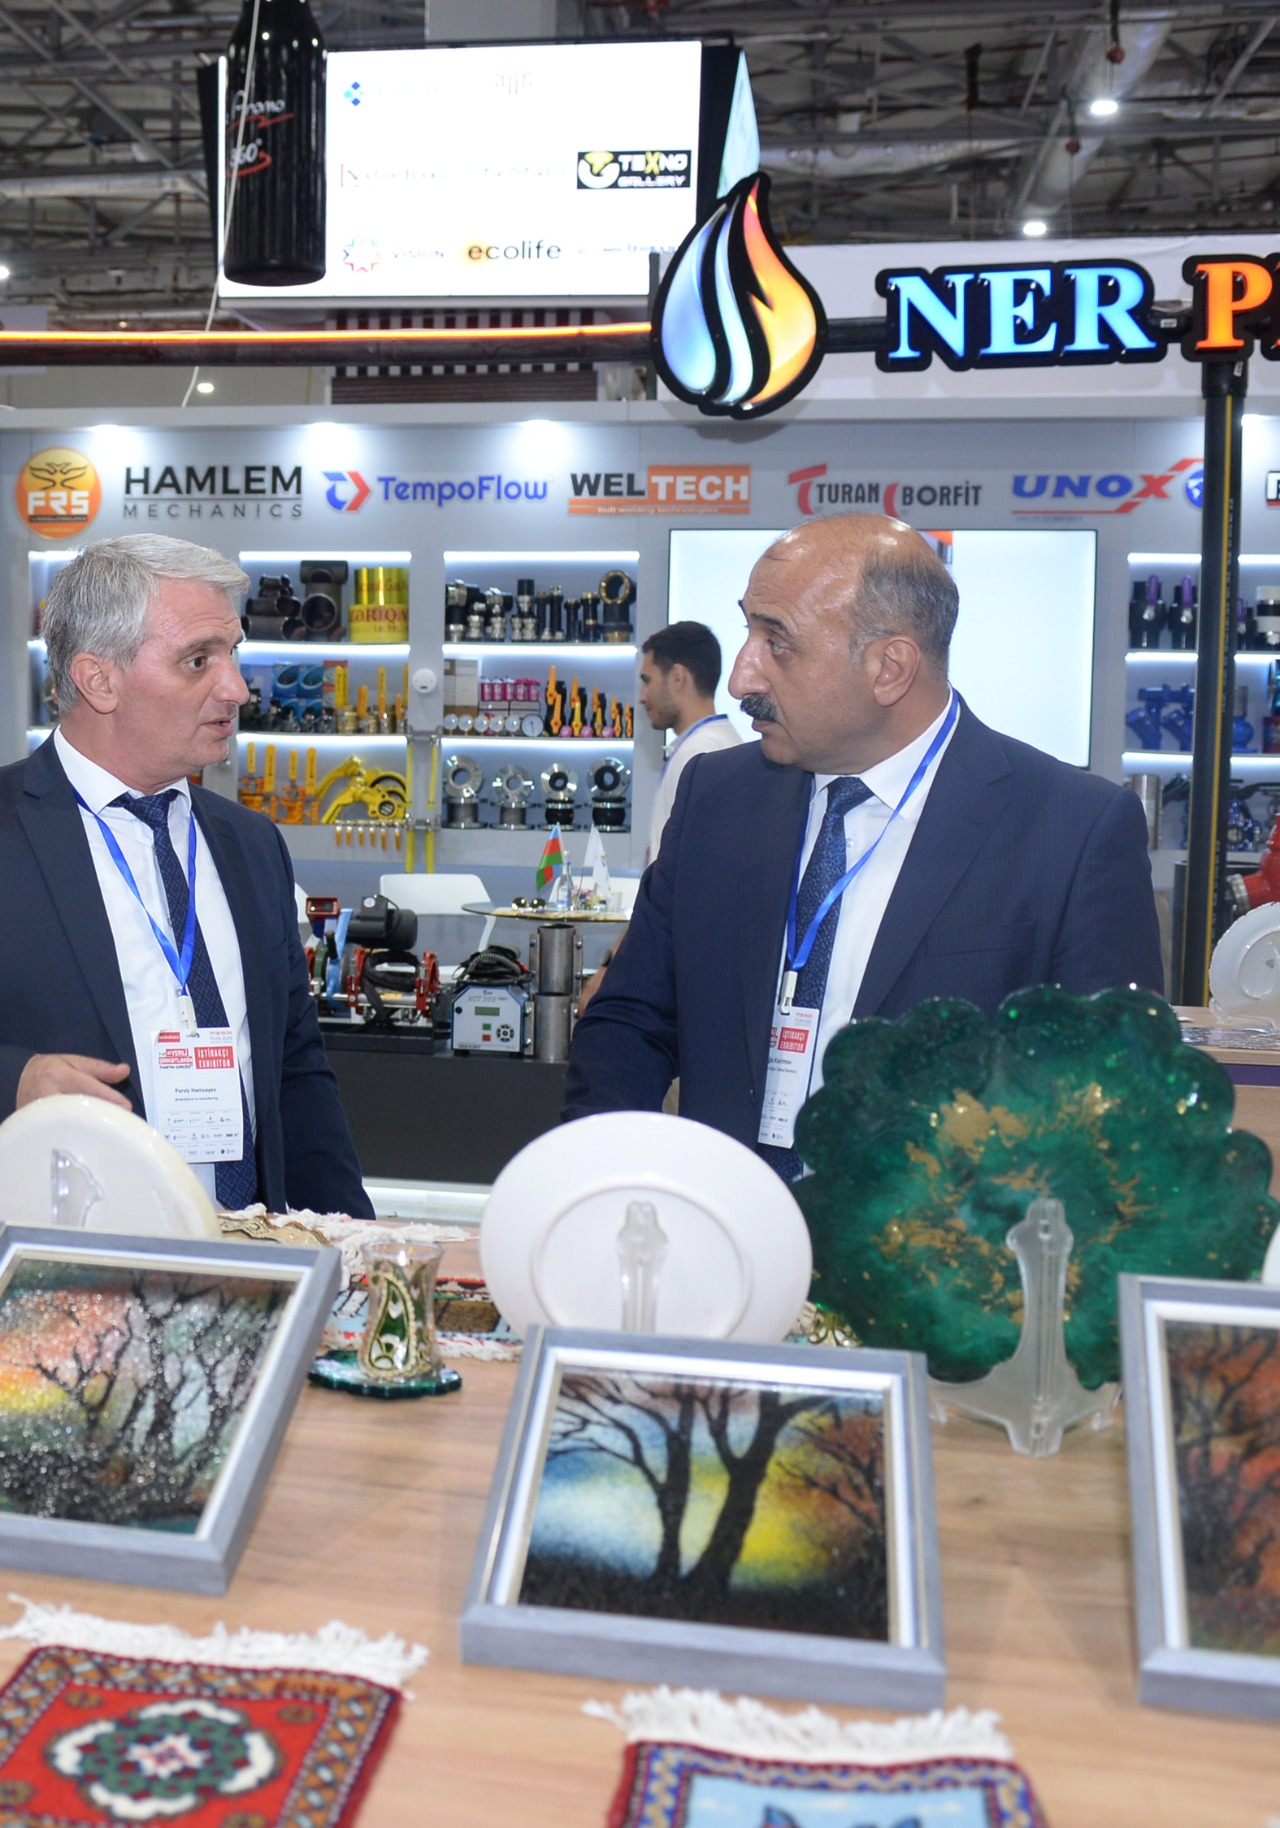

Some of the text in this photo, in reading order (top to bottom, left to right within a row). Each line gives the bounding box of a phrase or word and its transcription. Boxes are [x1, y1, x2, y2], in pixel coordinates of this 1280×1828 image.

[618, 151, 688, 175] TEXNO
[467, 239, 562, 260] ecolife
[886, 260, 1280, 360] NER P
[124, 465, 303, 495] HAMLEM
[377, 475, 548, 508] TempoFlow
[1012, 473, 1176, 499] UNOX
[816, 482, 880, 504] TURAN
[123, 503, 303, 519] MECHANICS
[199, 1059, 231, 1069] EXHIBITOR
